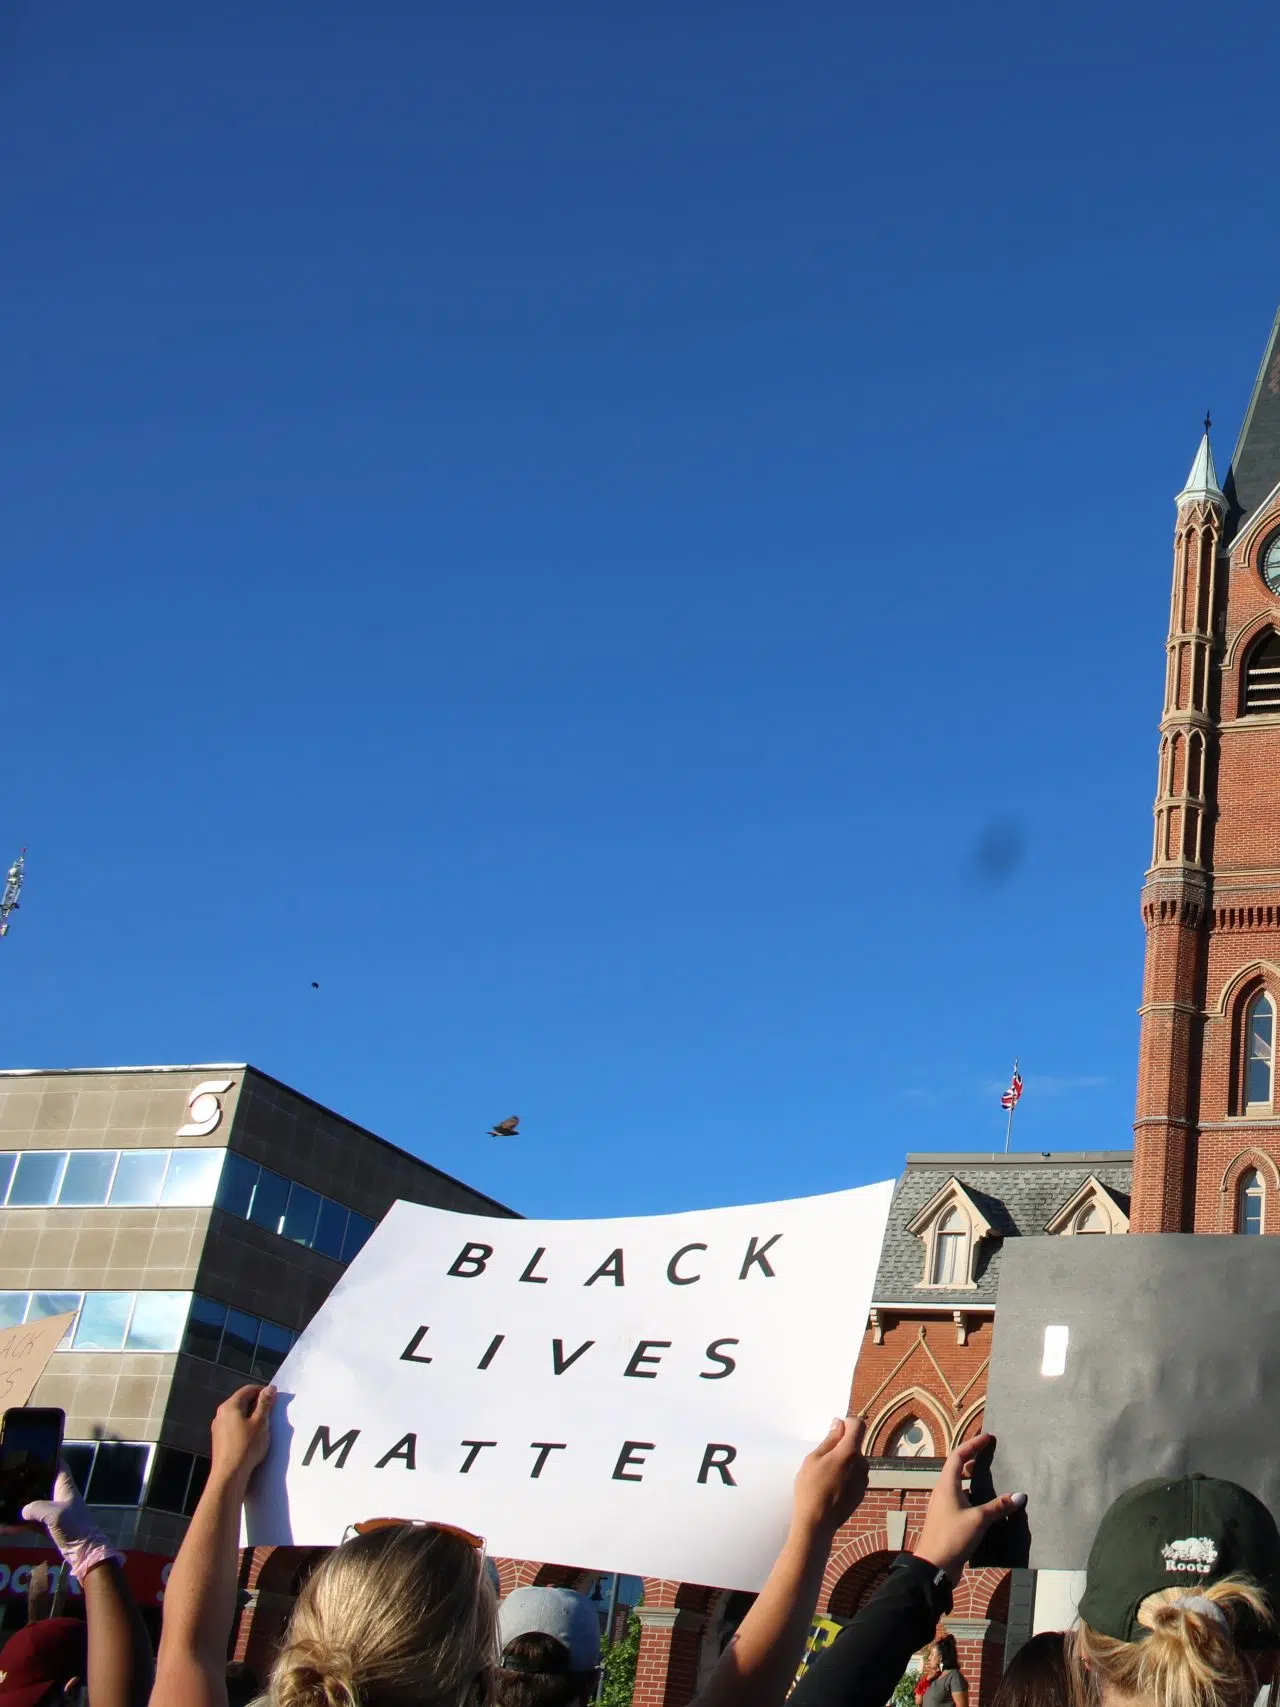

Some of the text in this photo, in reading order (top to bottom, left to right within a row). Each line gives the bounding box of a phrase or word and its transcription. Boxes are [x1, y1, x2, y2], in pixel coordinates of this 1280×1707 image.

[447, 1235, 781, 1286] BLACK
[0, 1330, 44, 1359] ACK
[400, 1326, 738, 1379] LIVES
[303, 1426, 736, 1485] MATTER
[1166, 1559, 1211, 1573] Roots
